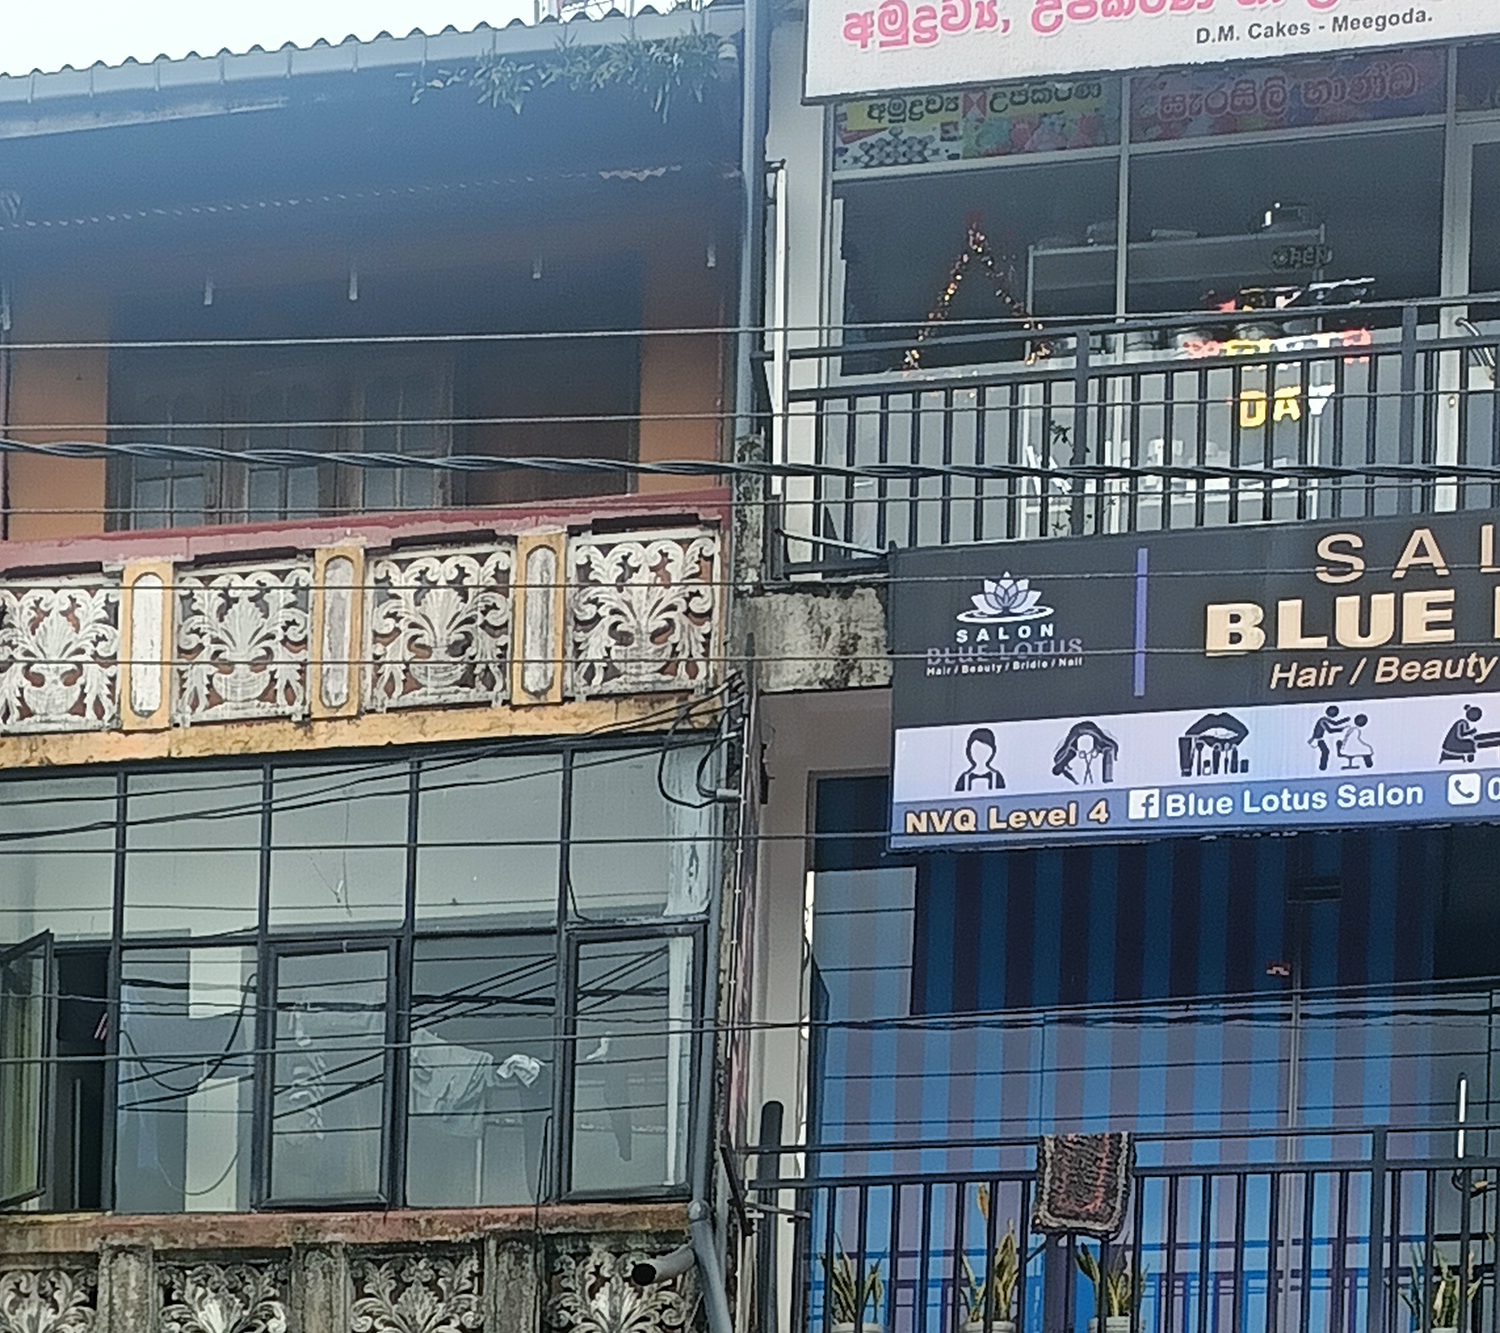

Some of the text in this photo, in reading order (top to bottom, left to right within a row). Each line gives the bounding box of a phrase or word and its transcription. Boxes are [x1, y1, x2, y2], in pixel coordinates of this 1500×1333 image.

[1195, 26, 1240, 45] D.M.
[1248, 21, 1312, 40] Cakes
[1331, 7, 1434, 34] Meegoda.
[955, 623, 1054, 643] SALON
[1205, 589, 1456, 657] BLUE
[926, 664, 952, 677] Hair
[961, 662, 1003, 675] Beauty
[927, 637, 1083, 666] BLUE LOTUS
[1270, 660, 1344, 690] Hair
[1375, 651, 1499, 684] Beauty
[1165, 779, 1424, 818] Blue Lotus Salon
[905, 801, 1109, 836] NVQ Level 4
